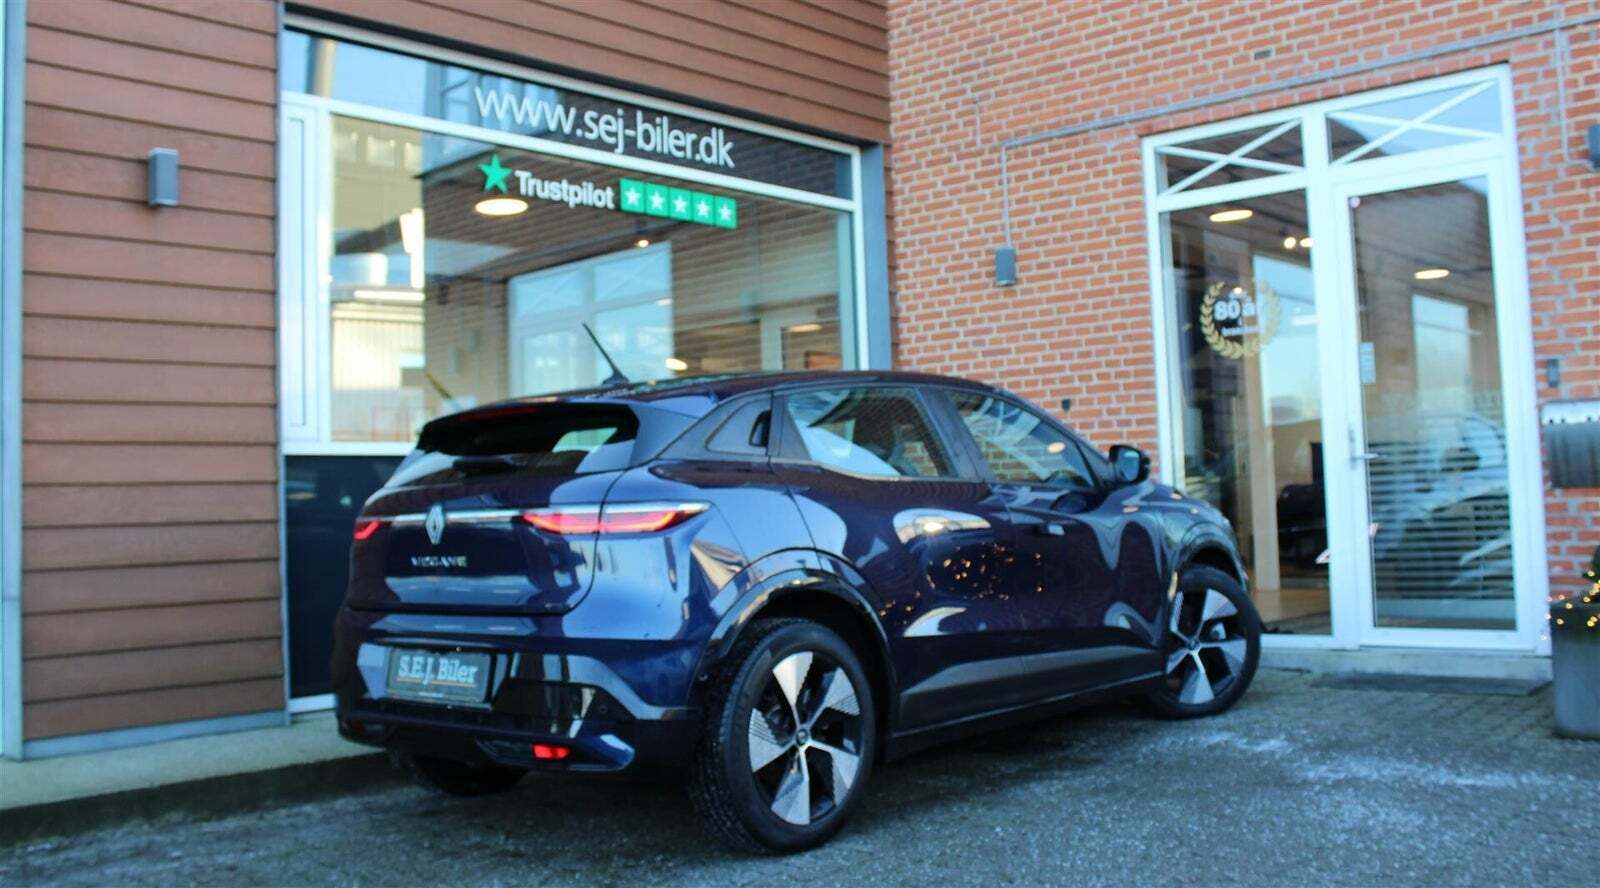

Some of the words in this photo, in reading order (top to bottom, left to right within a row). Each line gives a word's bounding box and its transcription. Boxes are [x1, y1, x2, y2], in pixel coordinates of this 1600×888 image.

[474, 86, 735, 168] www.sej-biler.dk
[515, 170, 615, 209] Trustpilot
[1214, 300, 1241, 321] 80
[437, 657, 478, 683] Biler
